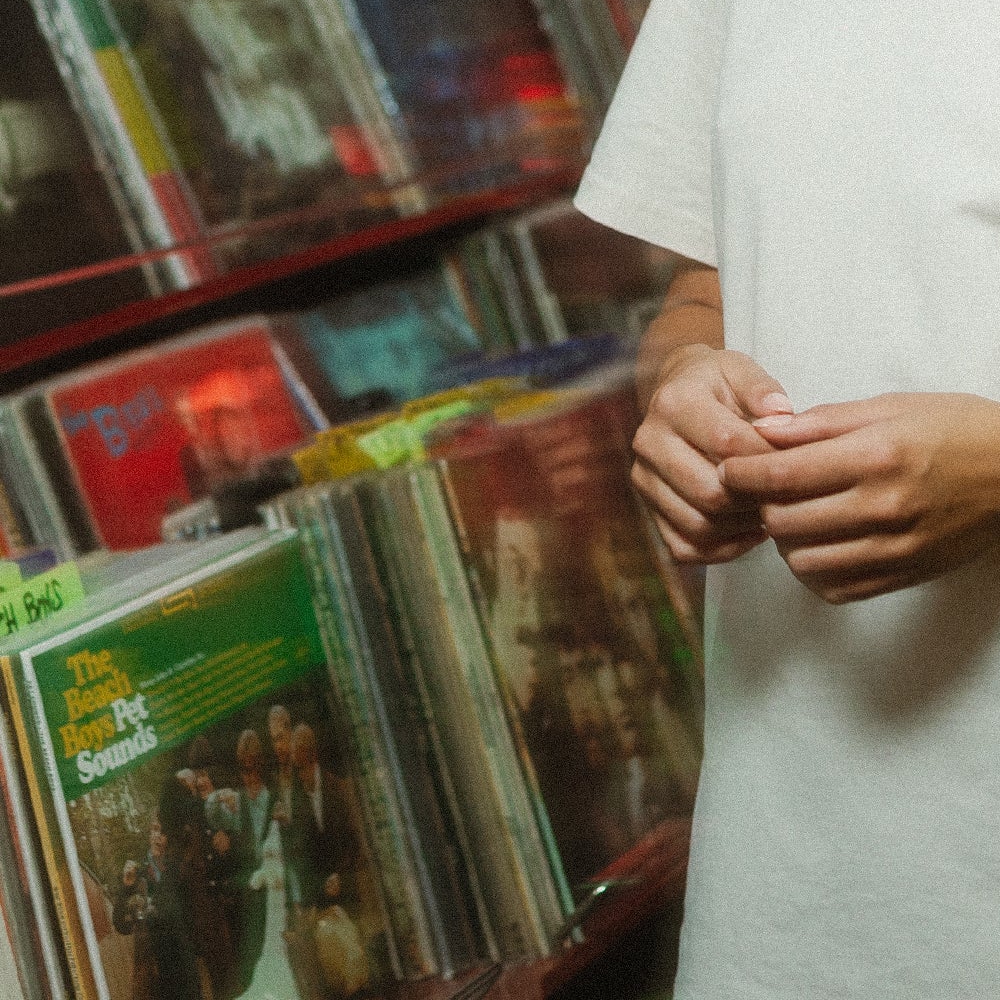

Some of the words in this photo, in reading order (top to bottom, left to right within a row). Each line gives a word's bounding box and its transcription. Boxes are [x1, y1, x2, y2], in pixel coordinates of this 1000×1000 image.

[62, 667, 133, 722] Beach
[66, 648, 112, 687] The
[58, 713, 115, 759] Boys
[111, 693, 149, 732] Pet
[77, 721, 157, 784] Sounds
